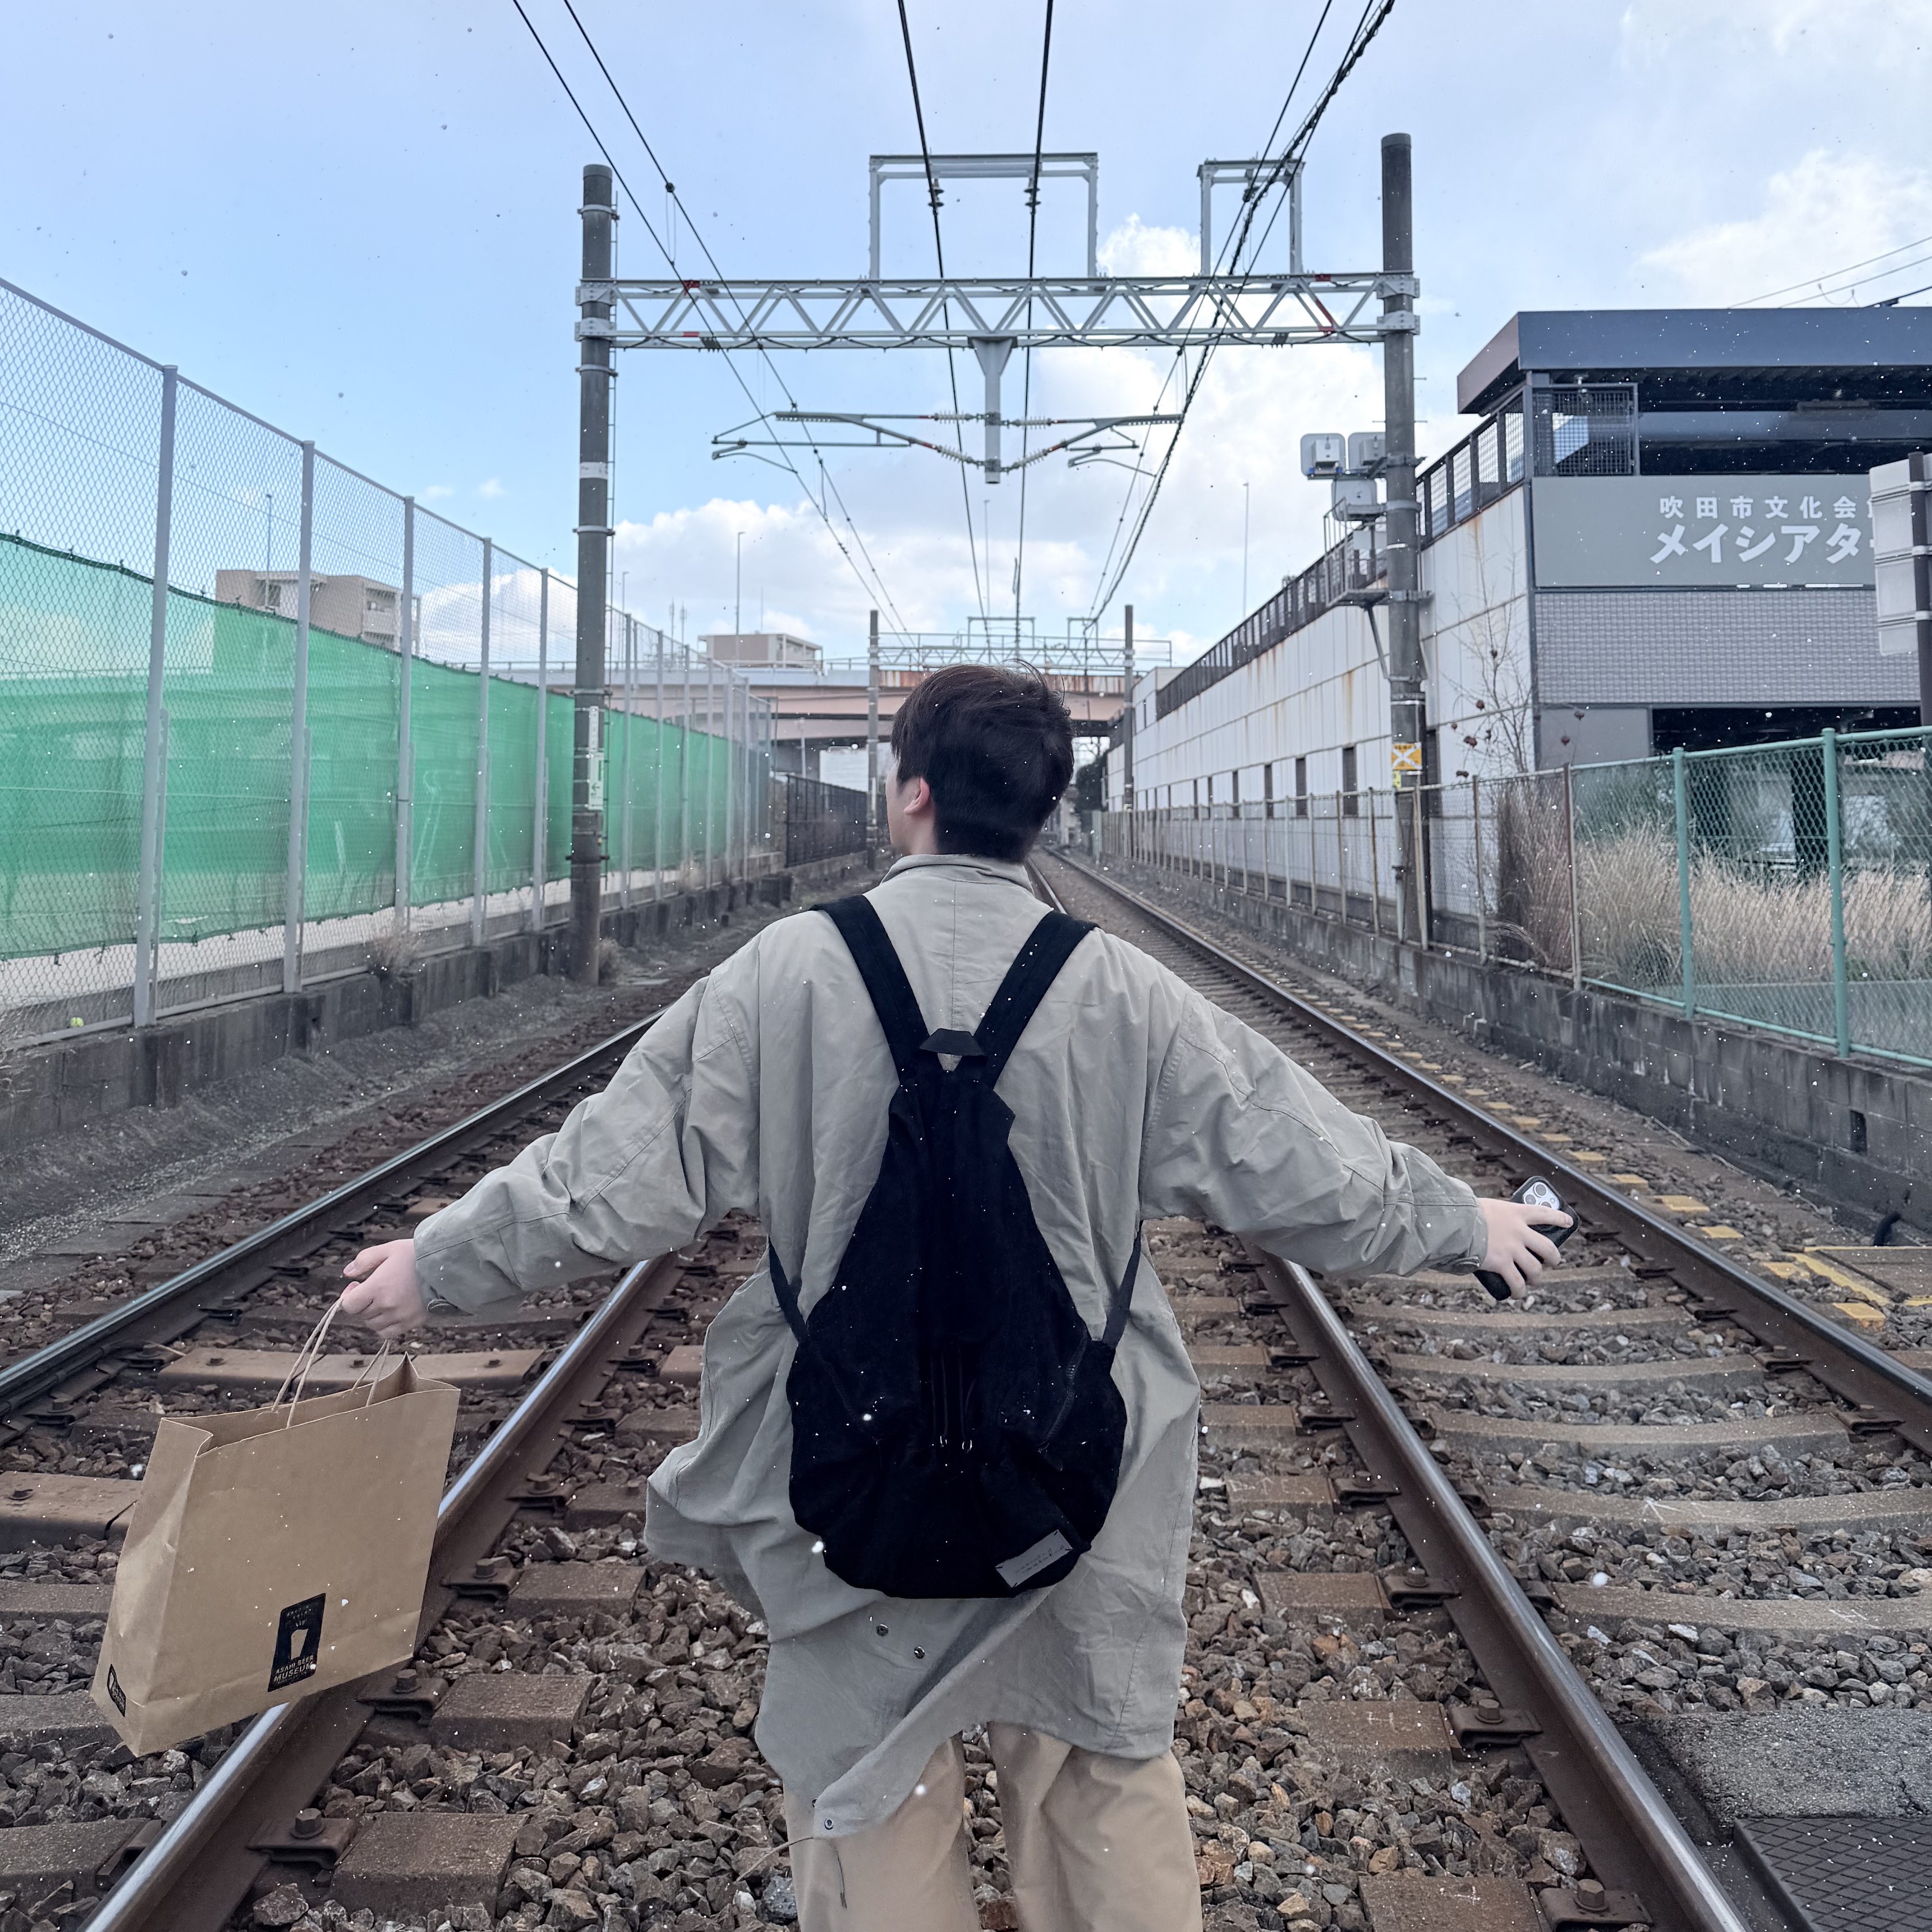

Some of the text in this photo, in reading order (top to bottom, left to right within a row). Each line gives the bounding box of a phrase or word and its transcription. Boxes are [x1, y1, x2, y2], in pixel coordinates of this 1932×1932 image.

[1660, 496, 1872, 518] 吹田市文化会
[1650, 523, 1874, 564] メイシアタ
[276, 1655, 313, 1674] ASAHI BEER
